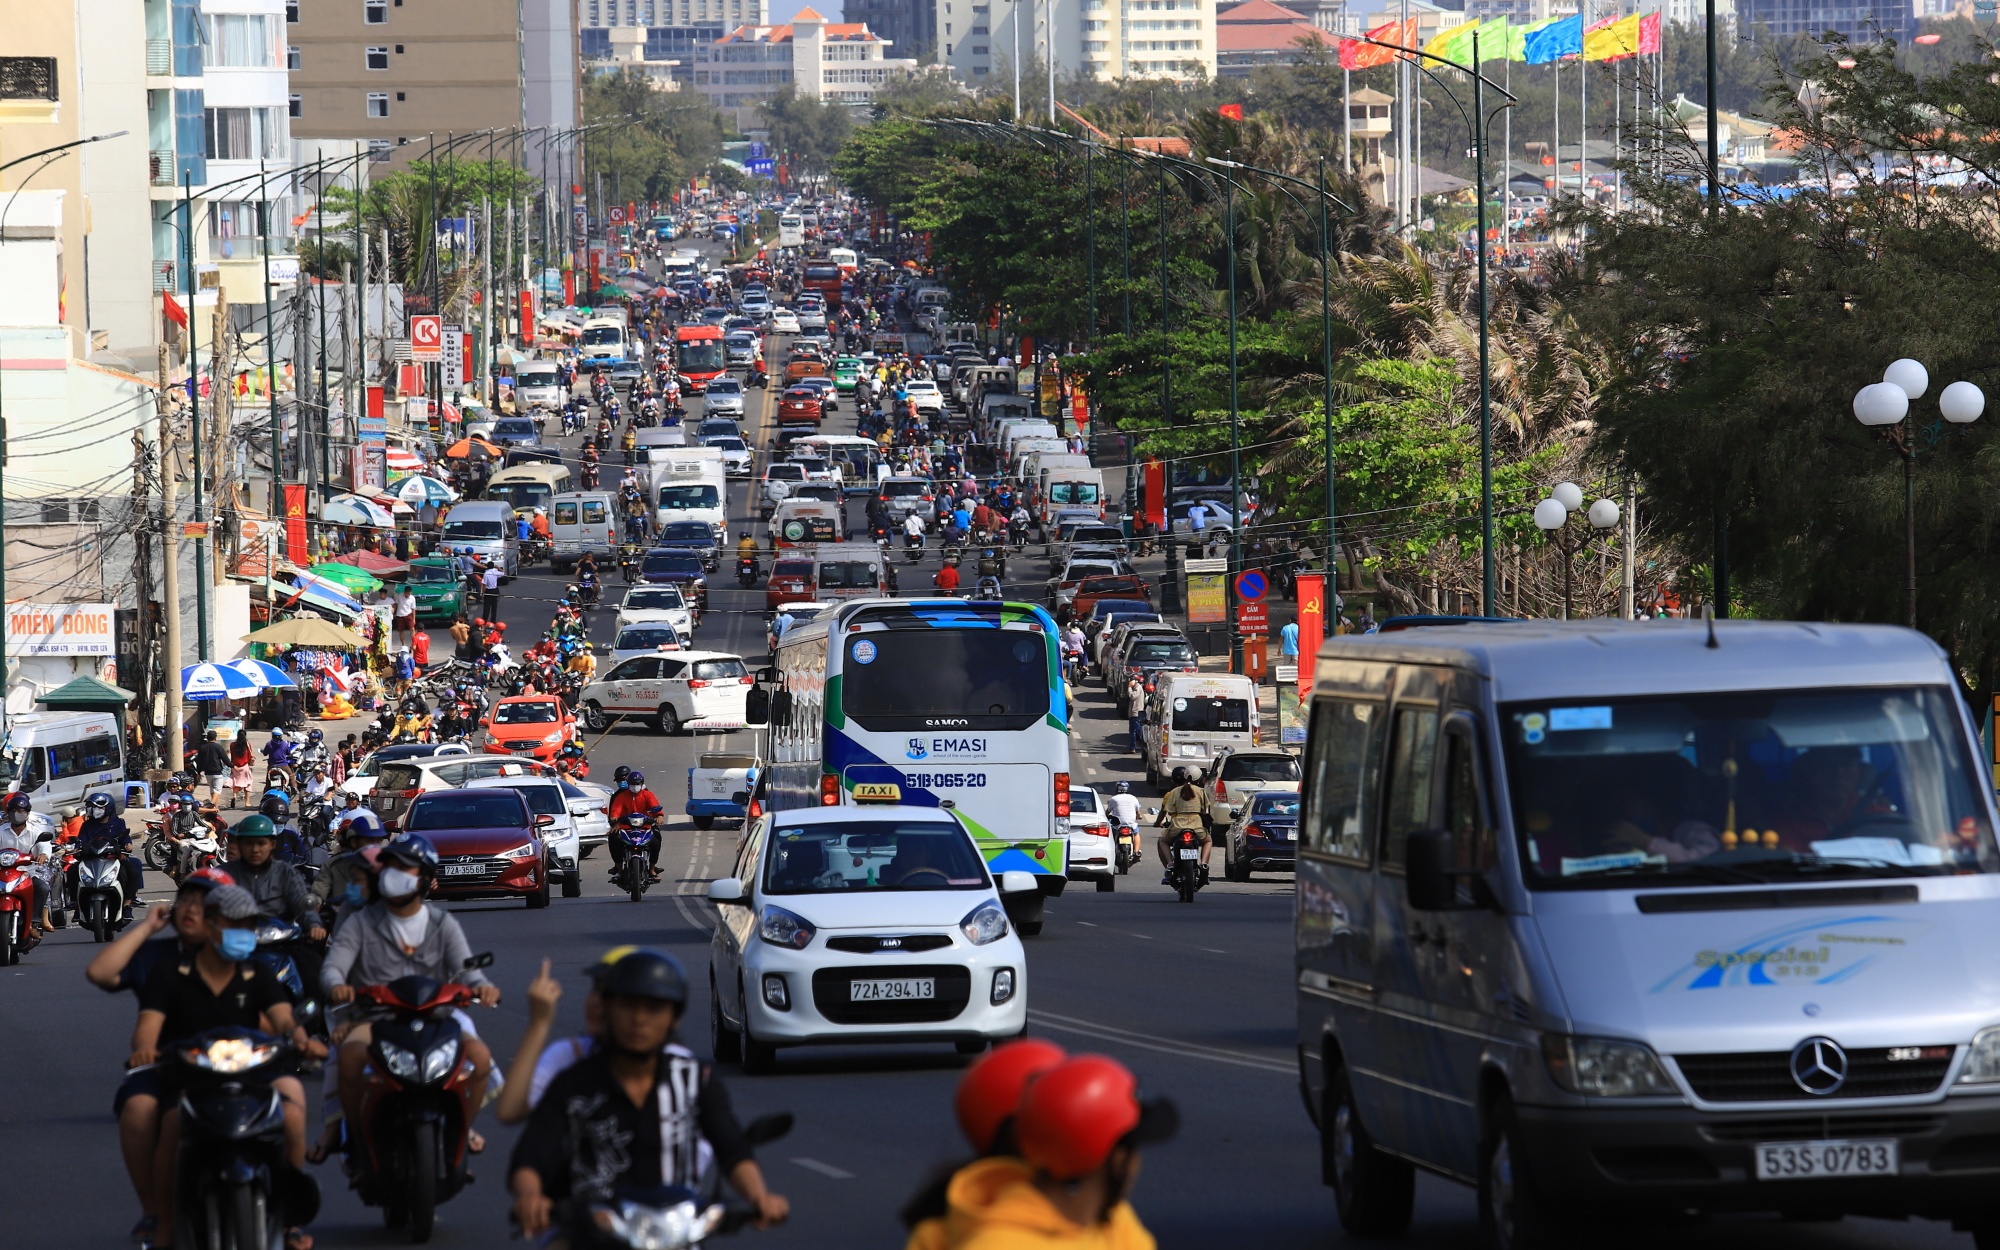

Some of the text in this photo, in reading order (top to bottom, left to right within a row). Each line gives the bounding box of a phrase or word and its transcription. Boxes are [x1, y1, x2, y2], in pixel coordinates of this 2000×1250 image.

[1246, 604, 1259, 613] CẤM
[11, 608, 108, 635] MIỀN ĐÔNG
[932, 739, 987, 751] EMASI
[859, 786, 892, 795] TAXI
[882, 939, 898, 947] KIA
[1695, 945, 1830, 969] Special
[853, 981, 932, 999] 72A-294.13
